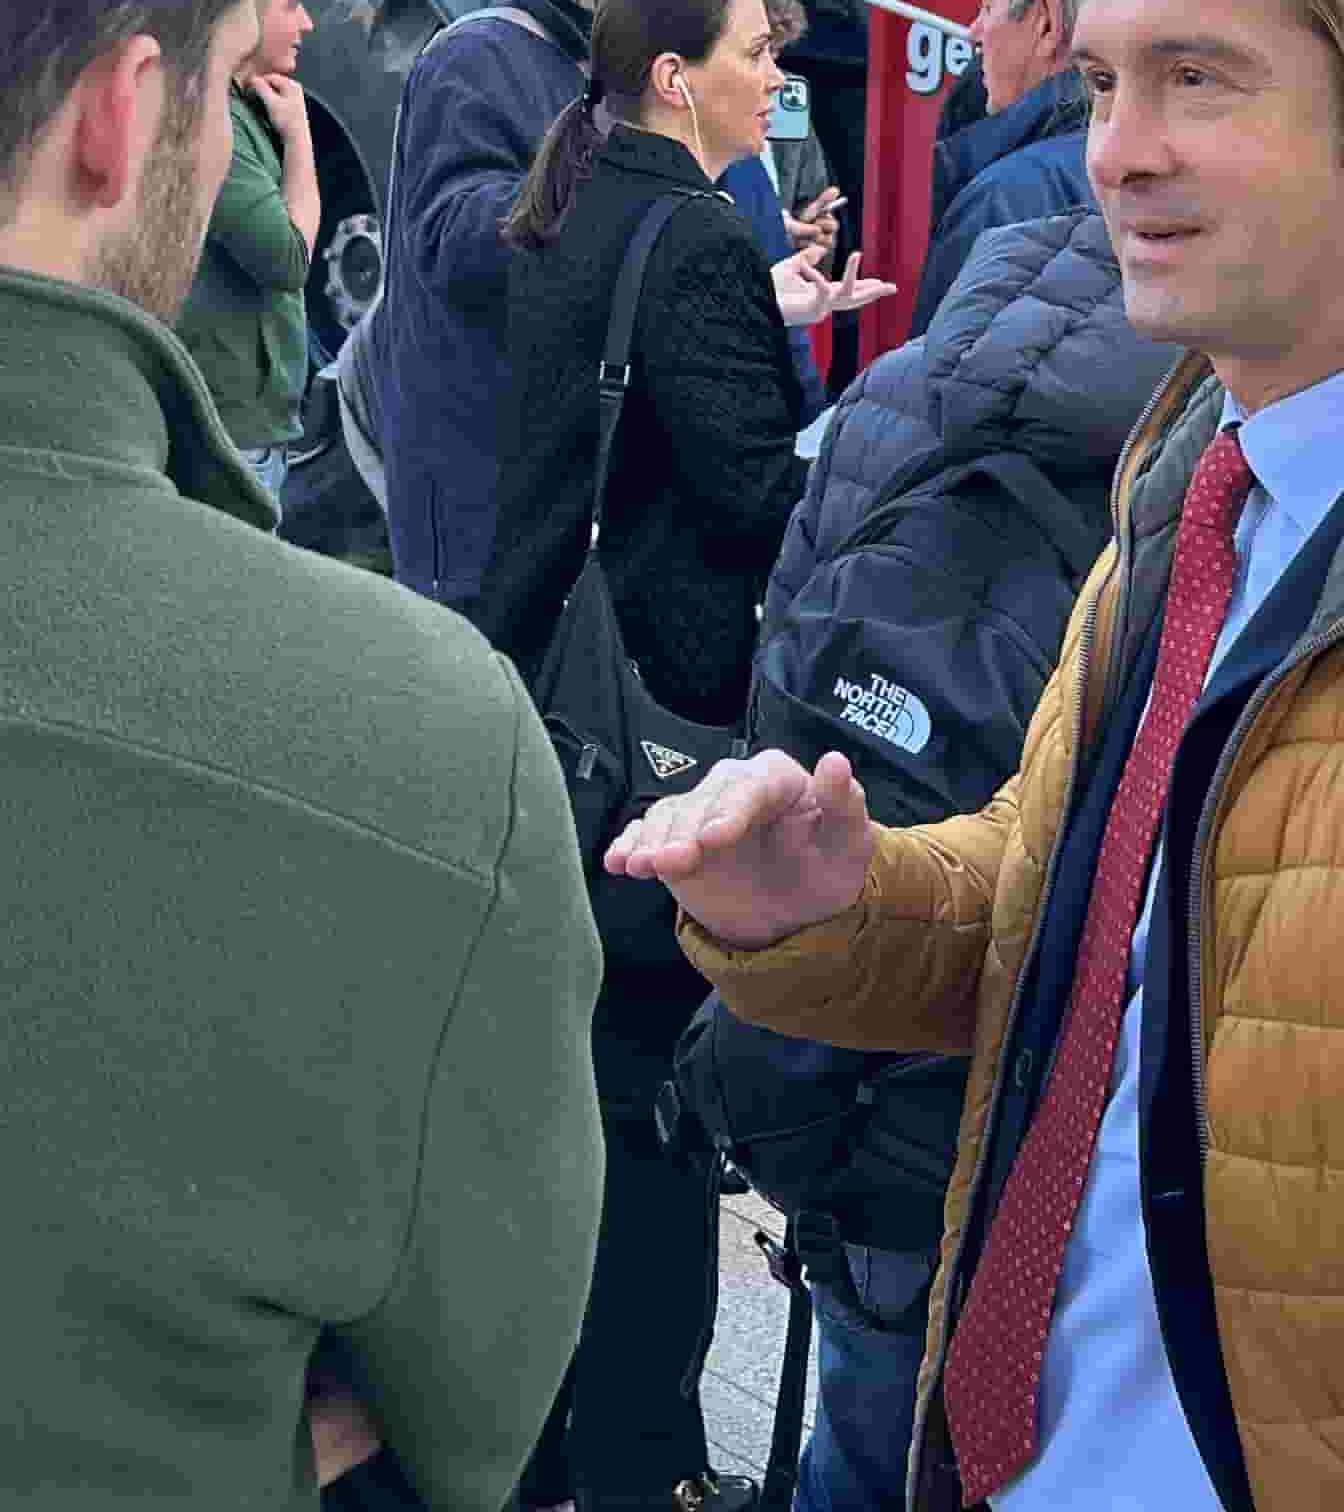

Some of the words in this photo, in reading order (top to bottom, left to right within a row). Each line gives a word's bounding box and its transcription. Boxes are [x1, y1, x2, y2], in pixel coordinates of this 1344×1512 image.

[905, 23, 979, 94] ge
[833, 677, 899, 724] NORTH
[871, 672, 911, 704] THE
[839, 702, 897, 741] FACE
